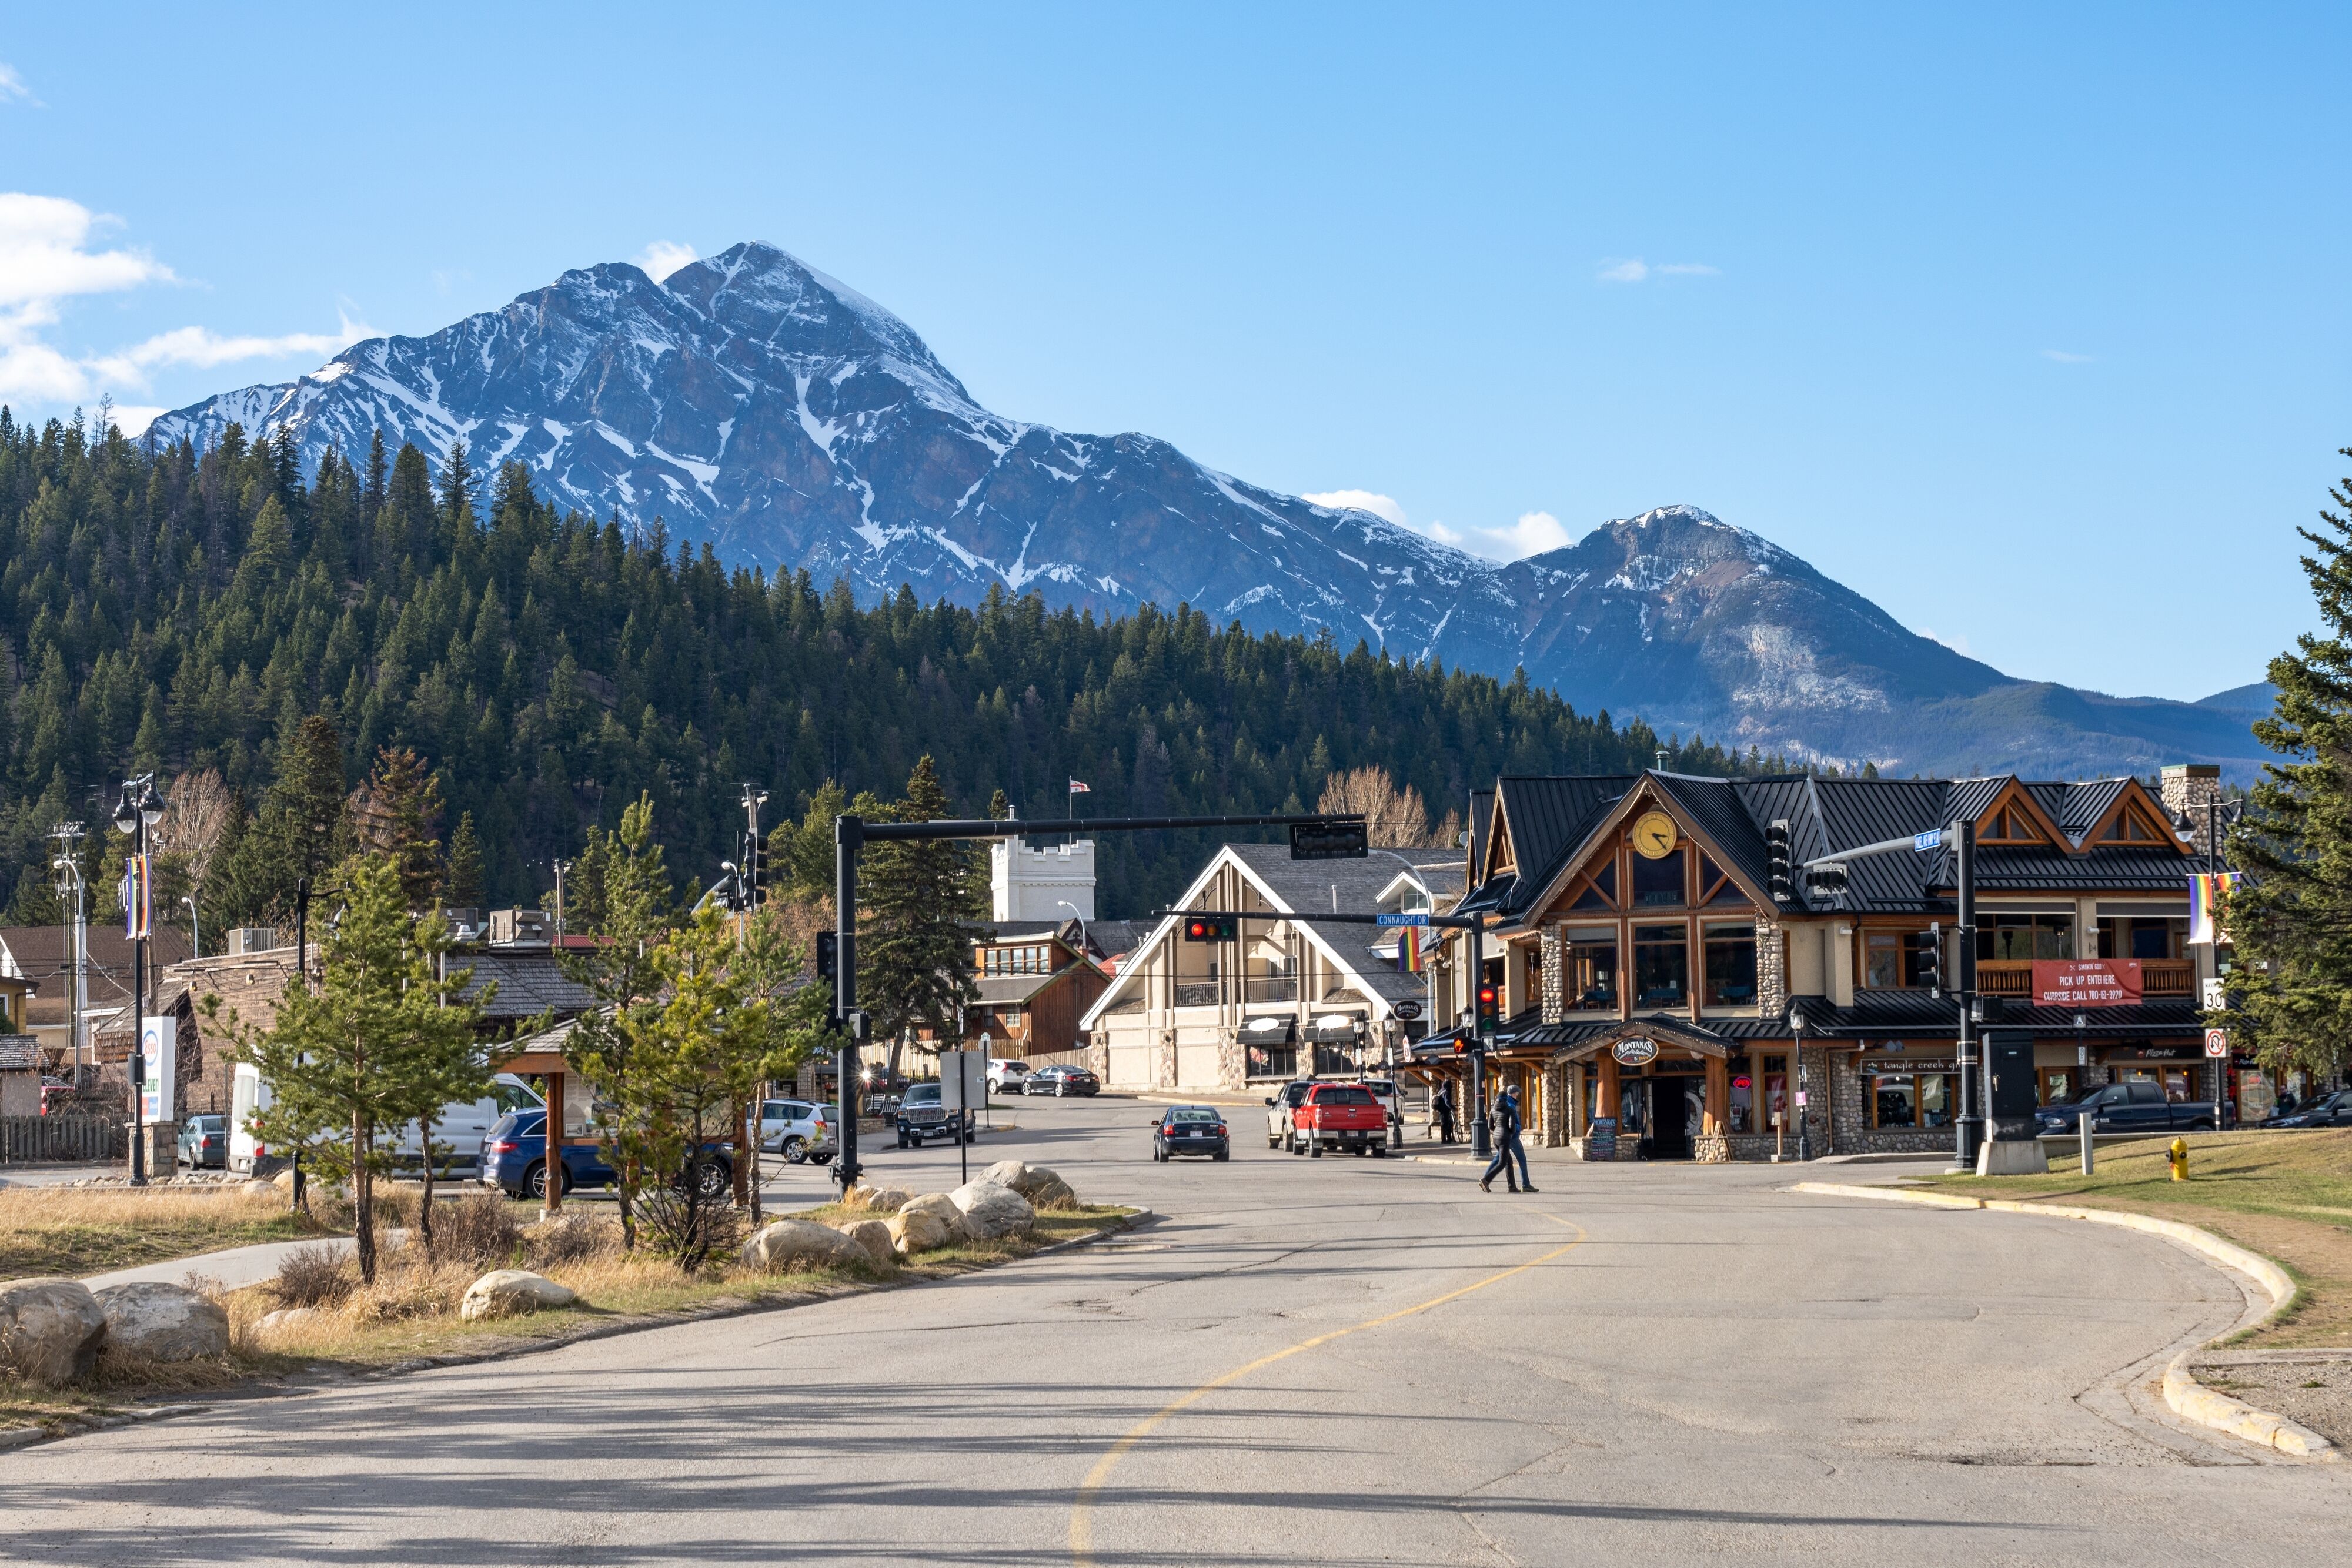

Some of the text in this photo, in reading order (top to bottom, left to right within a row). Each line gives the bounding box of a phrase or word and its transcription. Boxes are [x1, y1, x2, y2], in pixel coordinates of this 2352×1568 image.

[1379, 915, 1426, 925] CONNAUGHT DR
[2059, 974, 2116, 986] PICK UP ENTER HERE
[2044, 991, 2070, 1001] CURBSIDE
[2073, 991, 2087, 1001] CALL
[2206, 992, 2222, 1007] 30
[145, 1039, 157, 1054] Esso
[1618, 1041, 1653, 1055] MONTANA'S
[2146, 1048, 2177, 1057] Pizza Hut
[1883, 1059, 1913, 1072] tangle
[1918, 1059, 1944, 1069] creek
